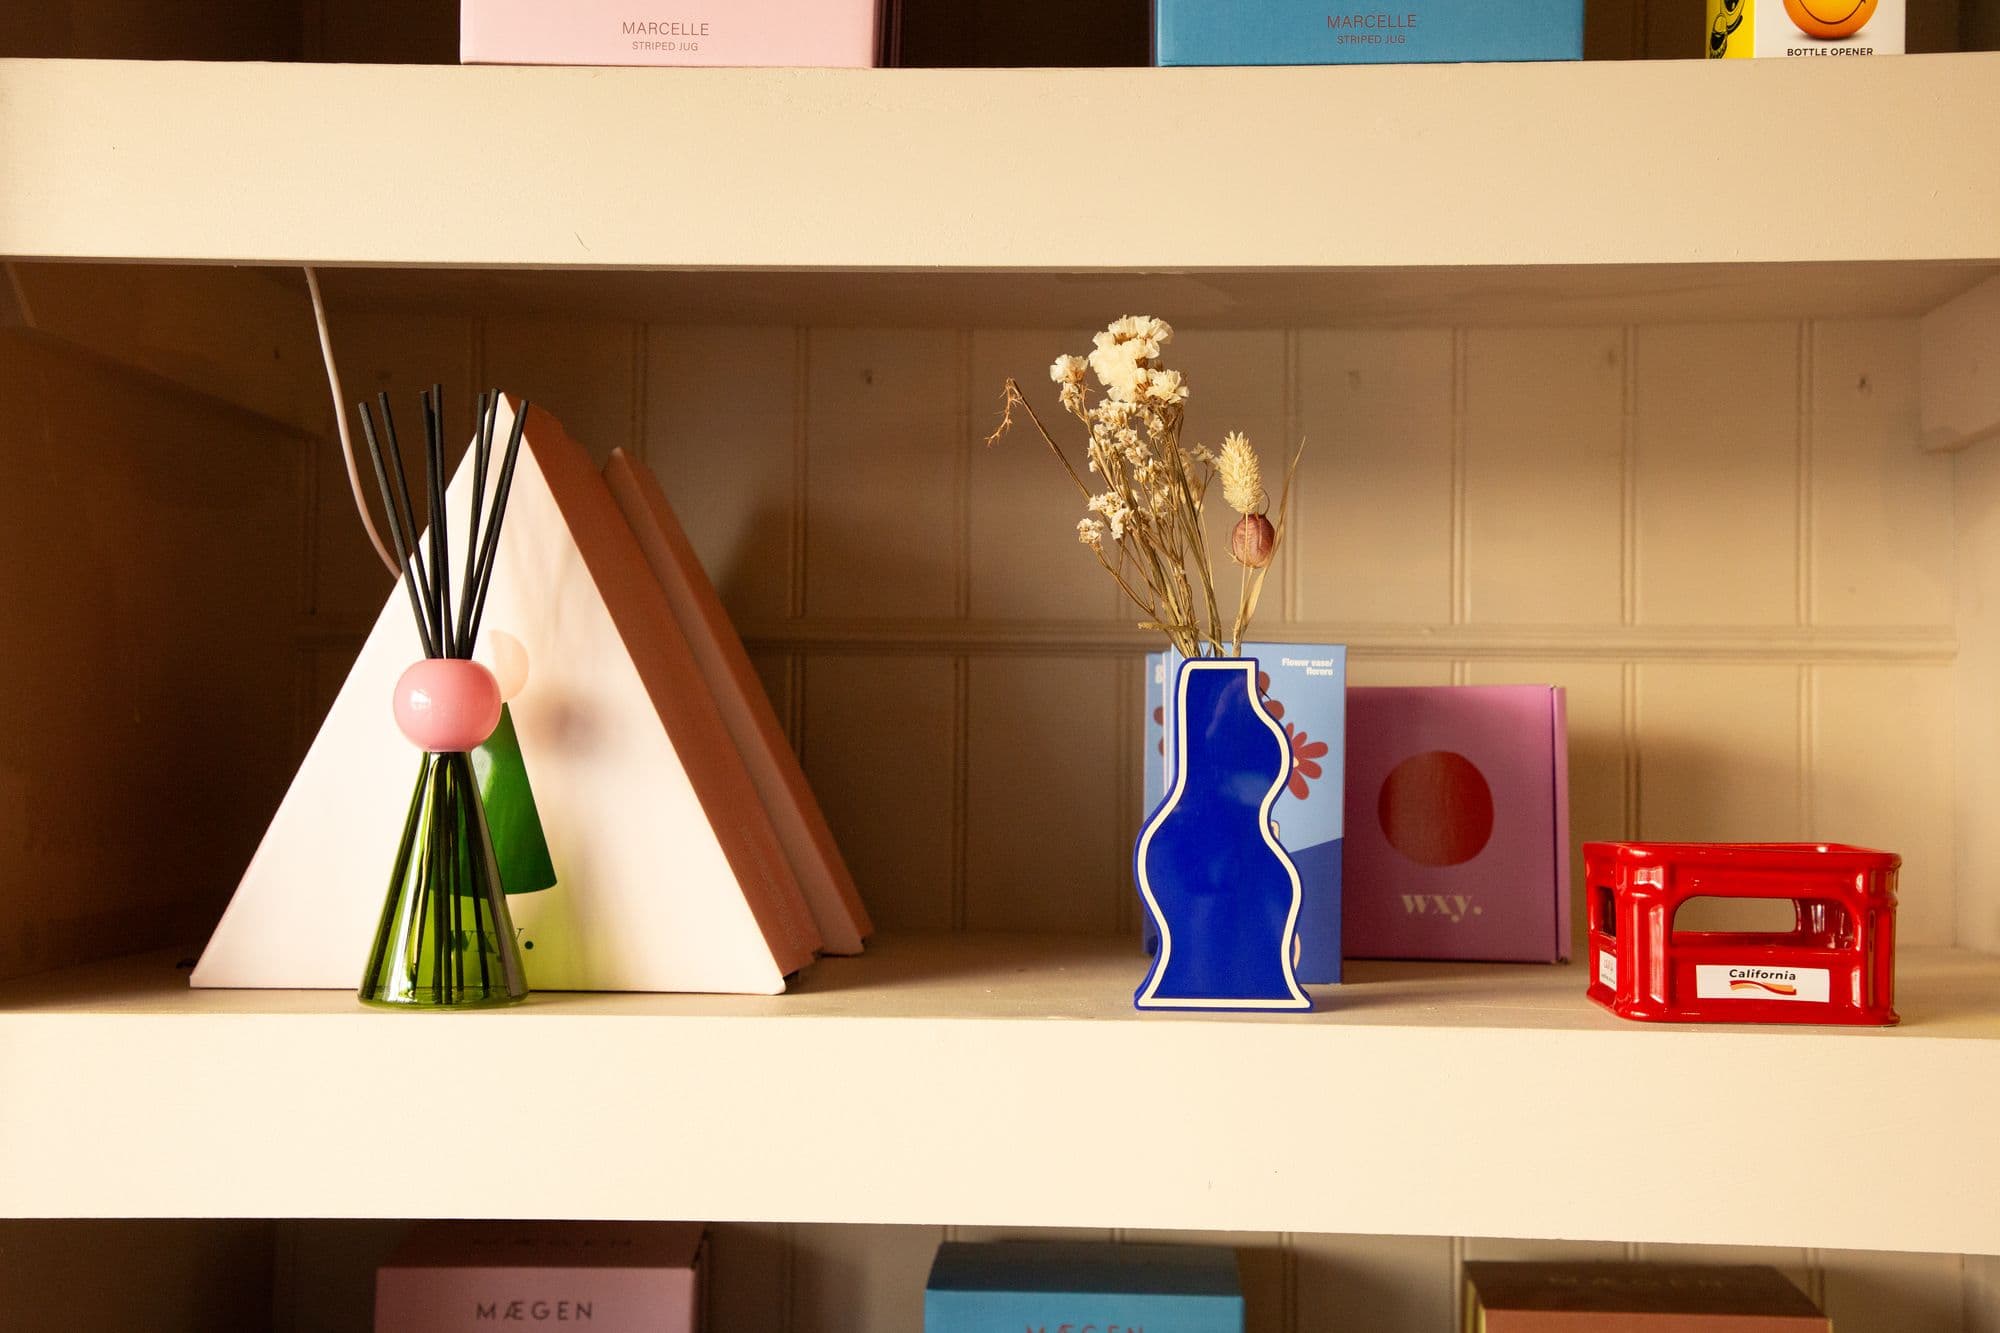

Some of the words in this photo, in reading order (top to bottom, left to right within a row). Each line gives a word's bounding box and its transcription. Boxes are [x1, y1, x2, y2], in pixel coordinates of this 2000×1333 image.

[1327, 14, 1417, 28] MARCELLE
[622, 22, 709, 36] MARCELLE
[1337, 35, 1382, 44] STRIPED
[1385, 35, 1406, 44] JUG
[632, 41, 676, 51] STRIPED
[679, 42, 698, 51] JUG
[1787, 48, 1828, 57] BOTTLE
[1830, 47, 1873, 56] OPENER
[1282, 657, 1309, 667] Flower
[1401, 895, 1483, 923] wxy.
[1729, 969, 1797, 981] California
[476, 1302, 593, 1320] MÆGEN
